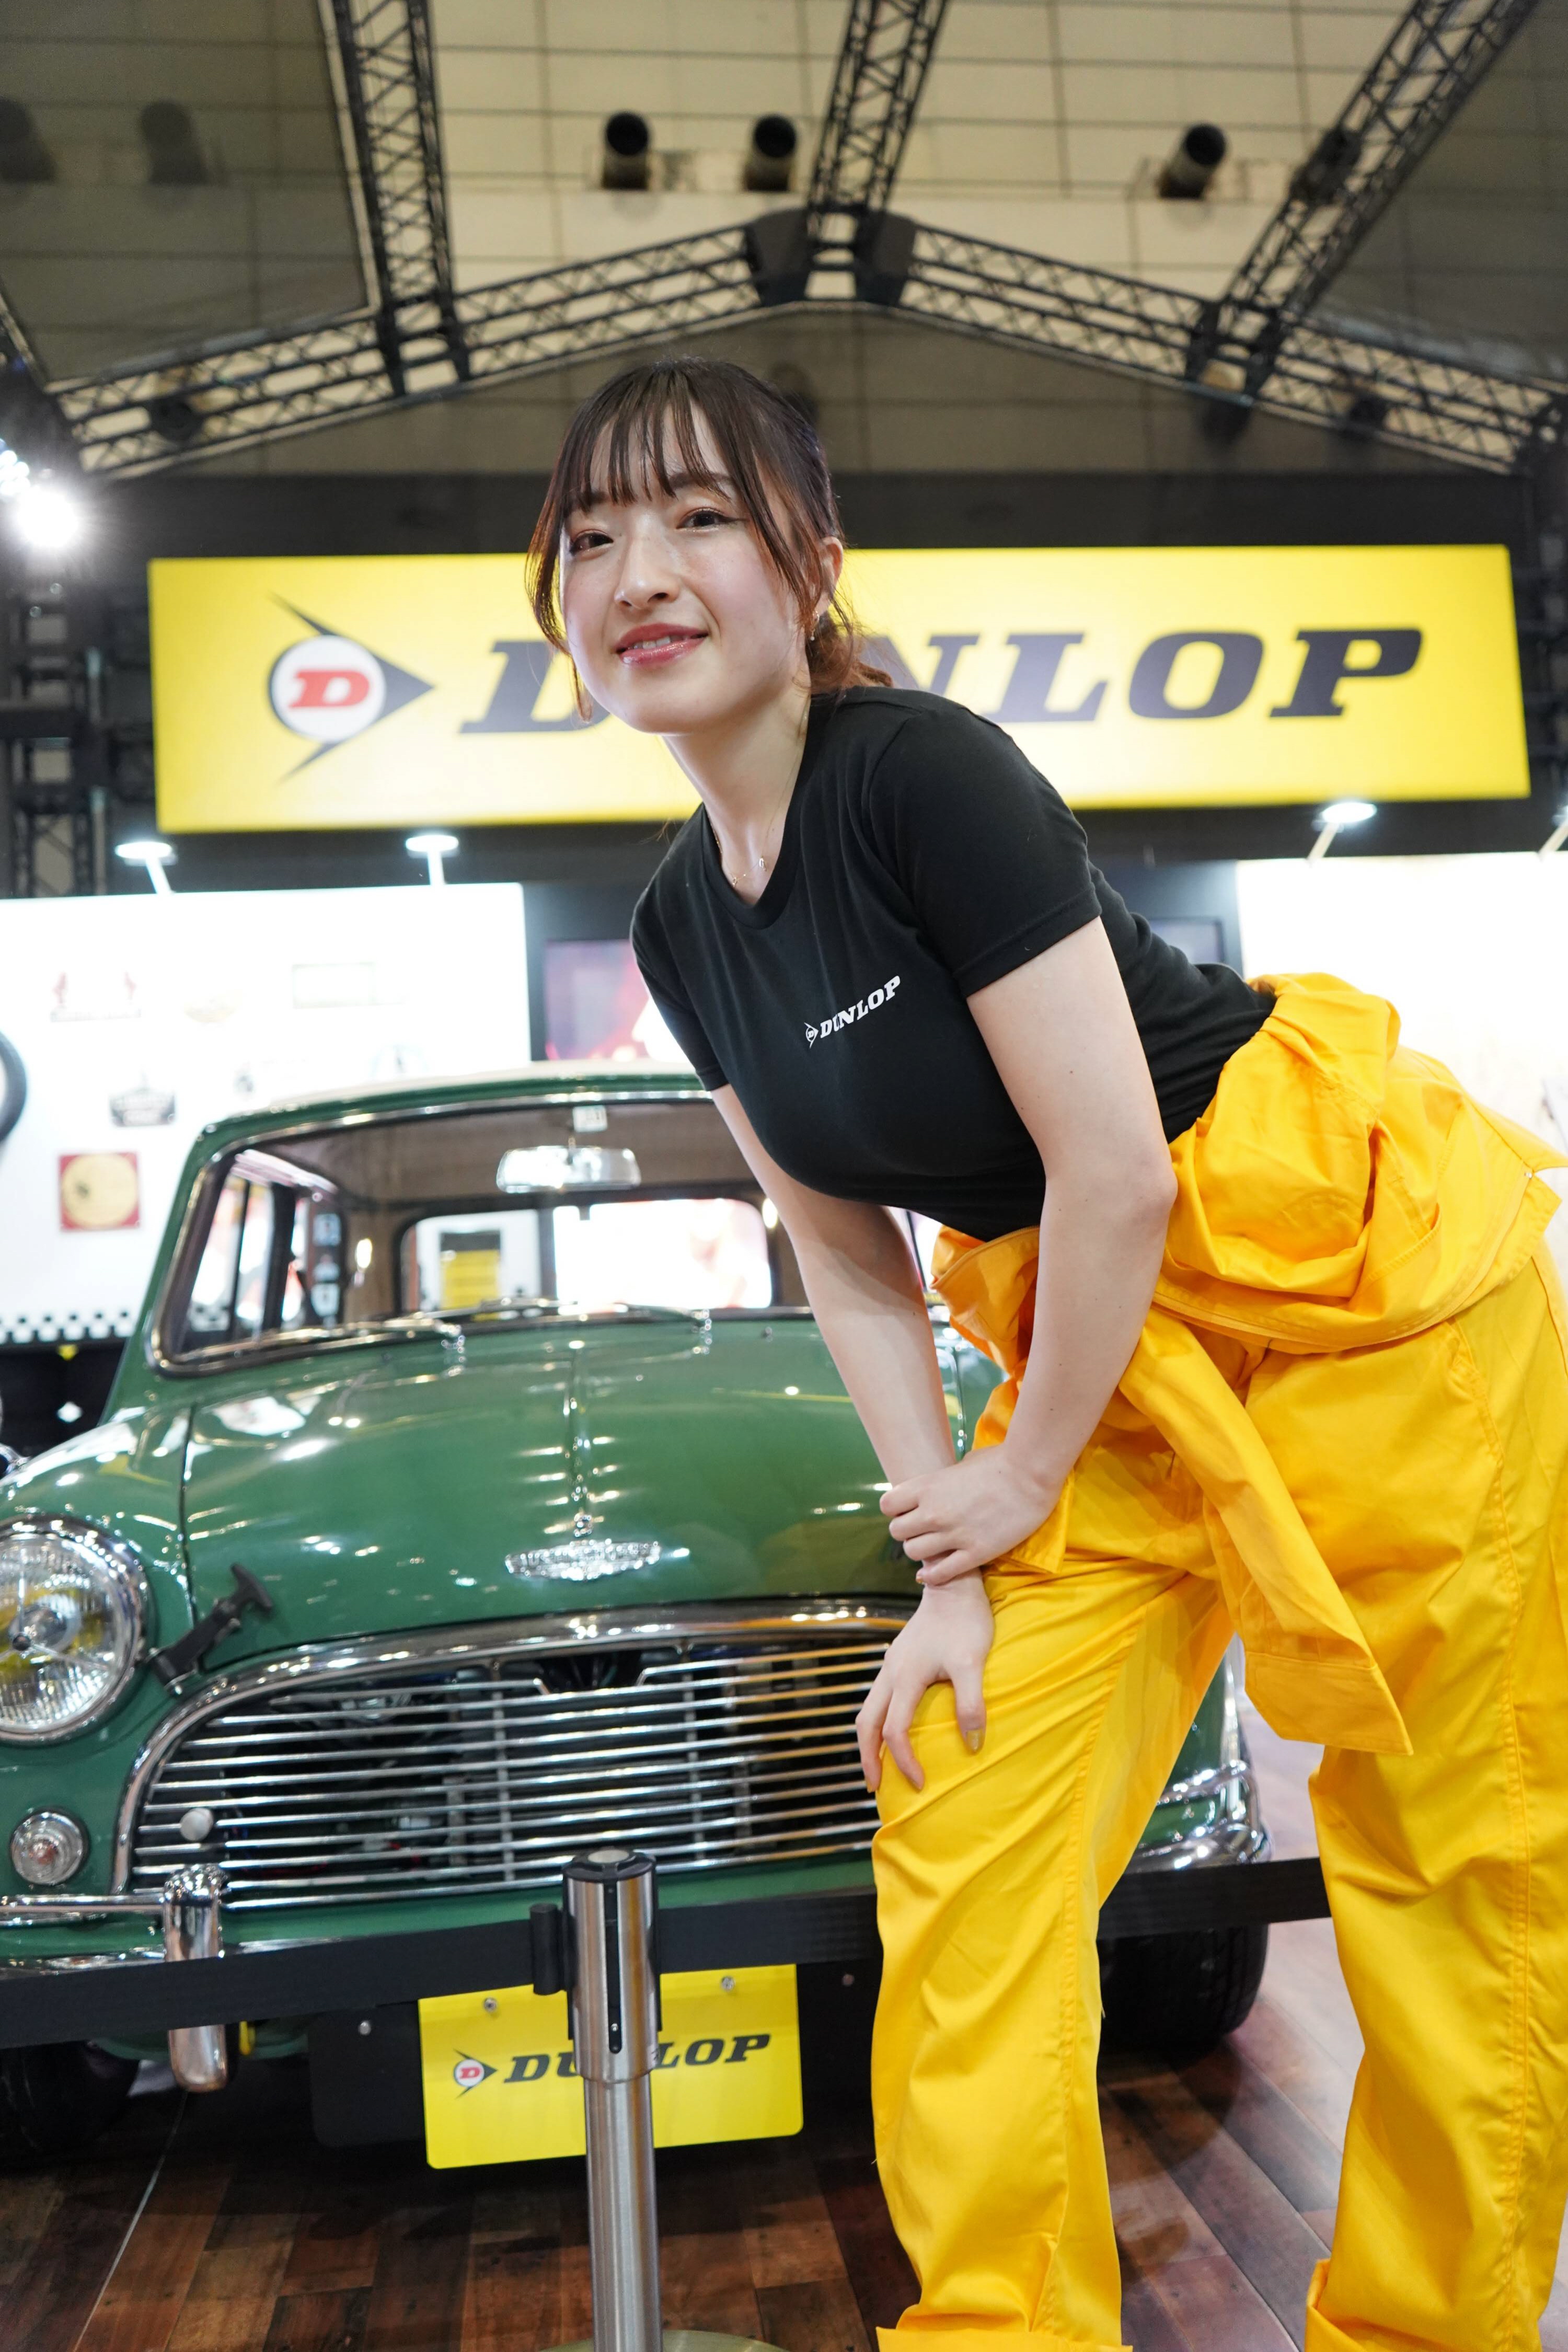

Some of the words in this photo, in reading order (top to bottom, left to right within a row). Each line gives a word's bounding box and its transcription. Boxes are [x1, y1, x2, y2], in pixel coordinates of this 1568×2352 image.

[289, 669, 370, 709] D
[460, 628, 1423, 734] DNLOP
[820, 975, 901, 1039] DUNLOP
[504, 2034, 771, 2083] DULOP
